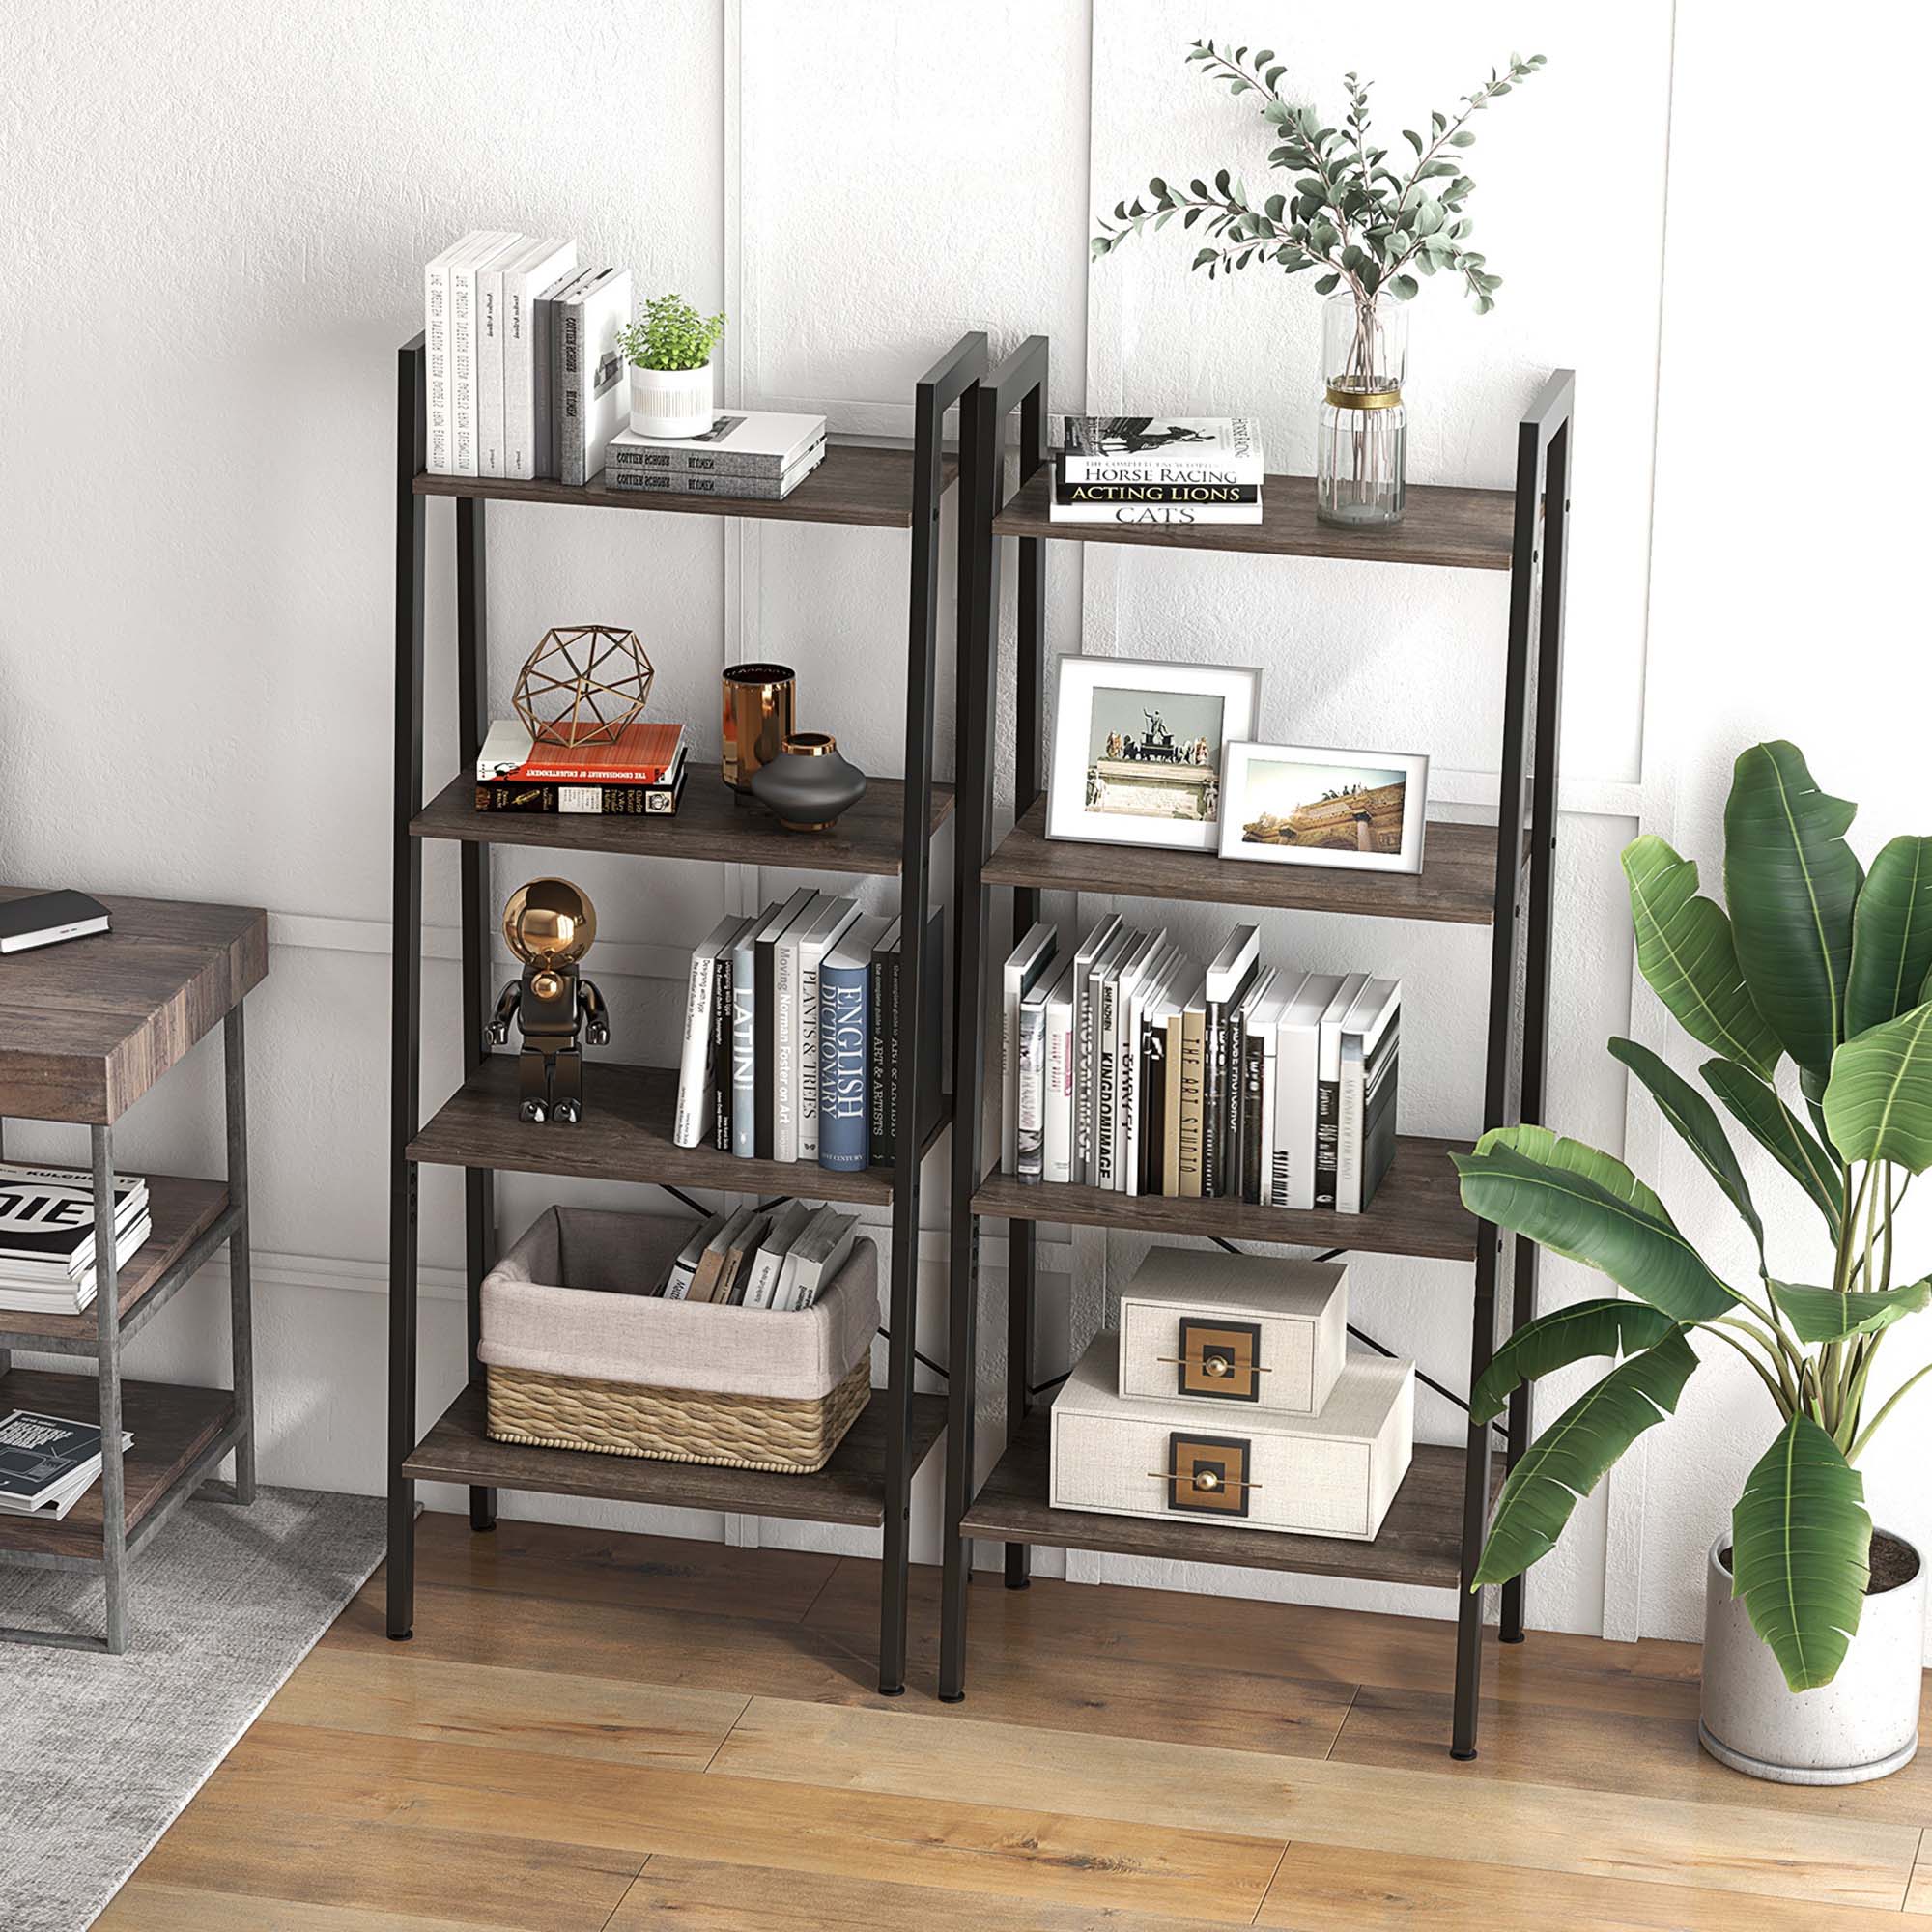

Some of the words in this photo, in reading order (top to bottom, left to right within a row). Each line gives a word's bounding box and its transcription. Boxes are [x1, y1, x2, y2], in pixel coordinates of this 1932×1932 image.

[1085, 469, 1152, 482] HORSE
[1160, 469, 1237, 483] RACING
[1071, 486, 1163, 501] ACTING
[1172, 486, 1240, 501] LIONS
[1115, 507, 1195, 524] CATS
[778, 948, 790, 991] Moving
[803, 970, 817, 1038] PLANTS
[780, 994, 791, 1042] Norman
[875, 1026, 881, 1035] to
[803, 1043, 817, 1055] &
[821, 984, 838, 1120] DICTIONARY
[837, 985, 864, 1120] ENGLISH
[873, 1037, 884, 1065] ART
[1182, 1038, 1200, 1065] THE
[780, 1046, 790, 1084] Foster
[873, 1066, 883, 1078] &
[780, 1087, 788, 1101] on
[803, 1061, 817, 1119] TREES
[1181, 1077, 1199, 1104] ART
[780, 1105, 790, 1123] Art
[873, 1080, 884, 1136] ARTISTS
[1179, 1118, 1198, 1174] STUDIO
